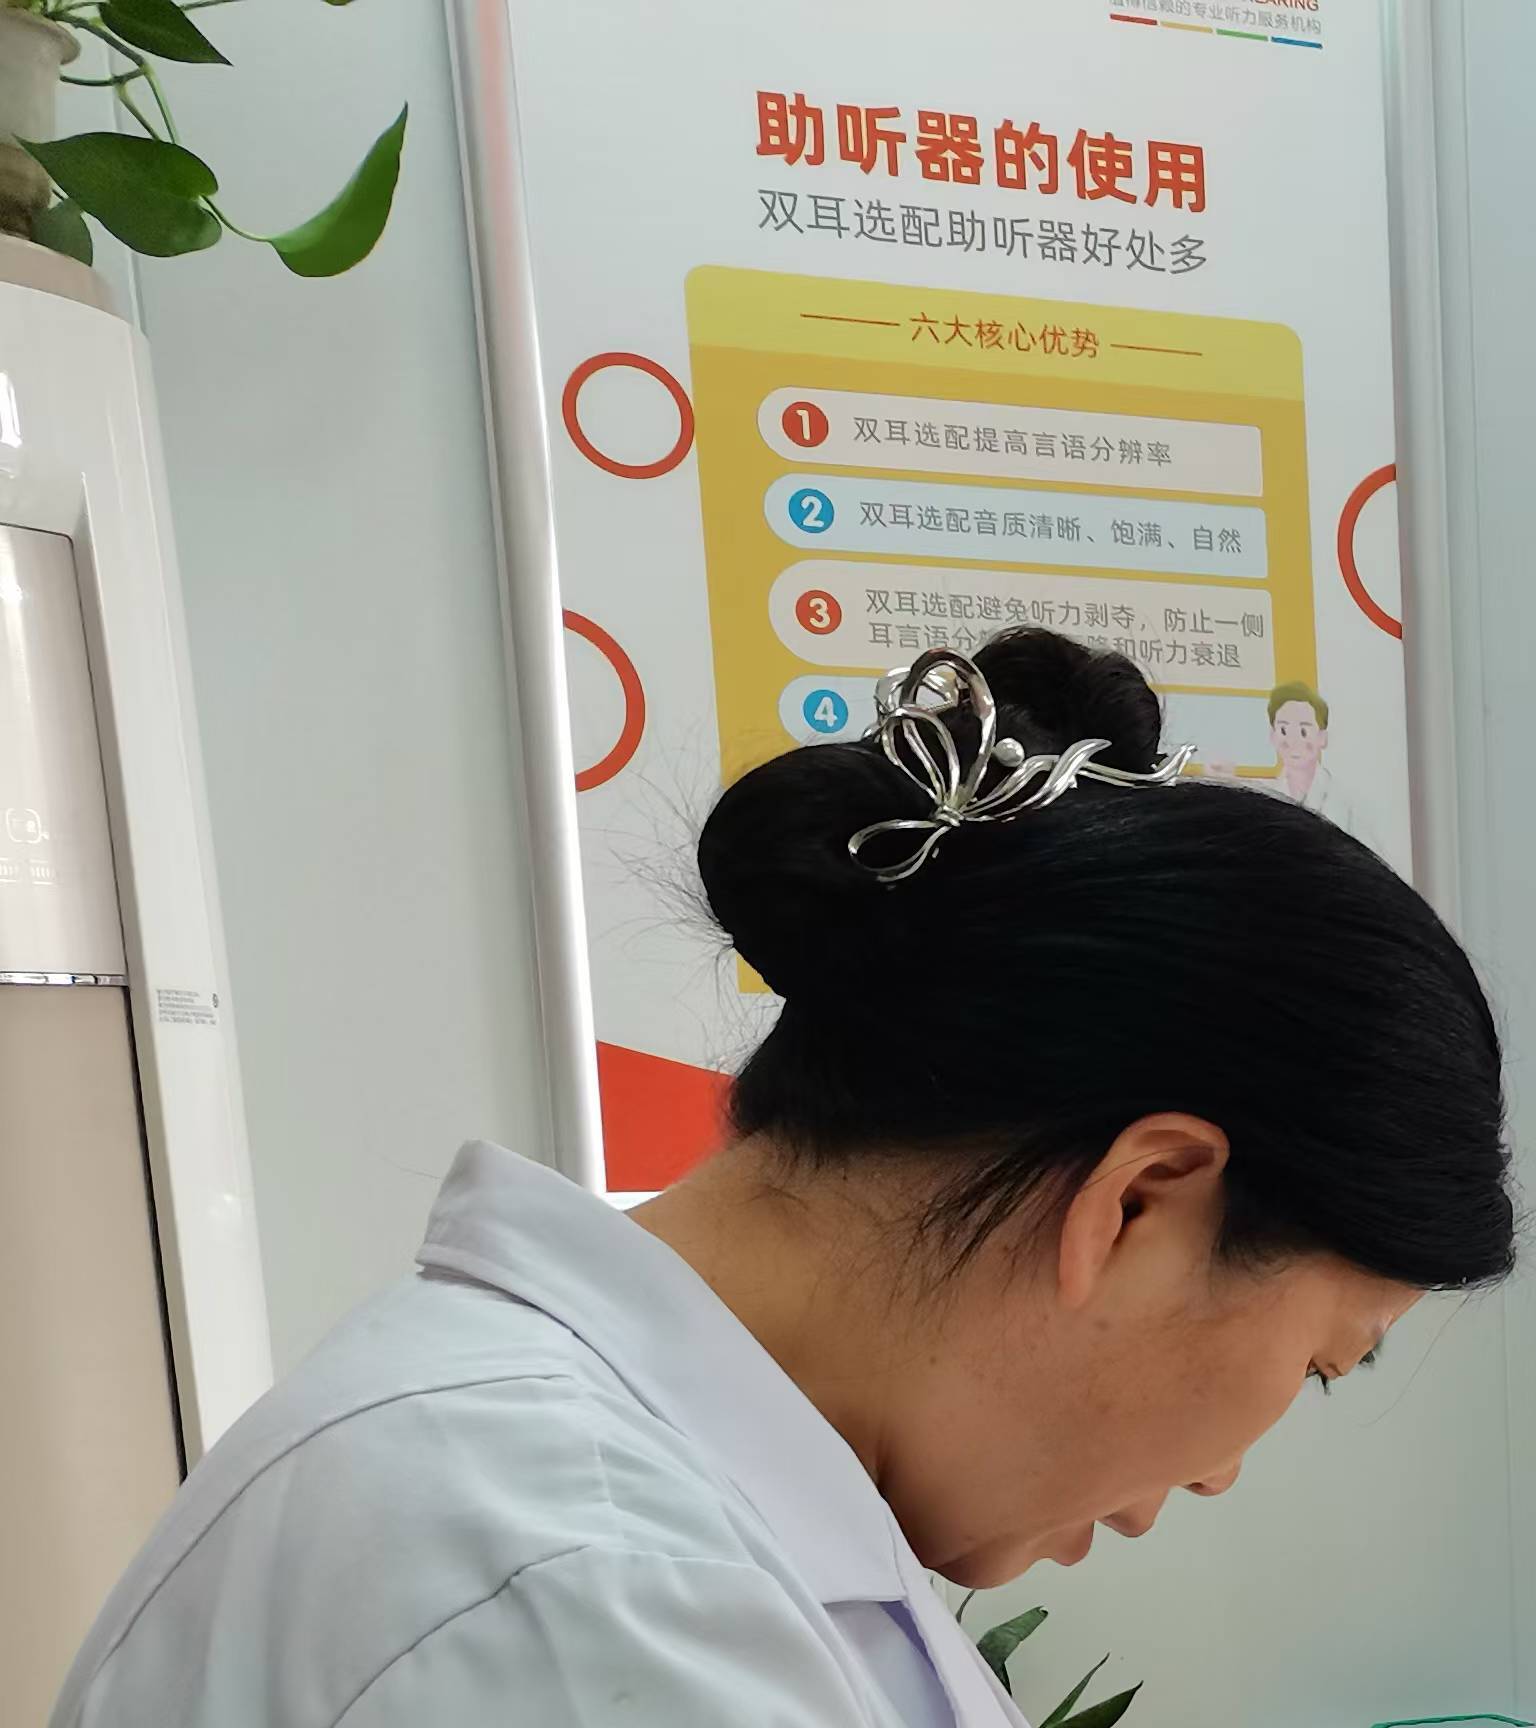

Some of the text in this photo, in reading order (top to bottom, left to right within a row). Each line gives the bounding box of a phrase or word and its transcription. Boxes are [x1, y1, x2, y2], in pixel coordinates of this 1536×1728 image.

[755, 89, 1208, 213] 助听器的使用
[757, 189, 1208, 275] 双耳选配助听器好处多
[909, 311, 1099, 359] 六大核心优势
[852, 416, 1173, 466] 双耳选配提高言语分辨率
[859, 501, 1243, 554] 双耳选配音质清晰、饱满、自然
[865, 589, 1264, 639] 双耳选配避免听力剥夺,防止一侧
[868, 622, 1241, 669] 耳言语分降和听力衰退
